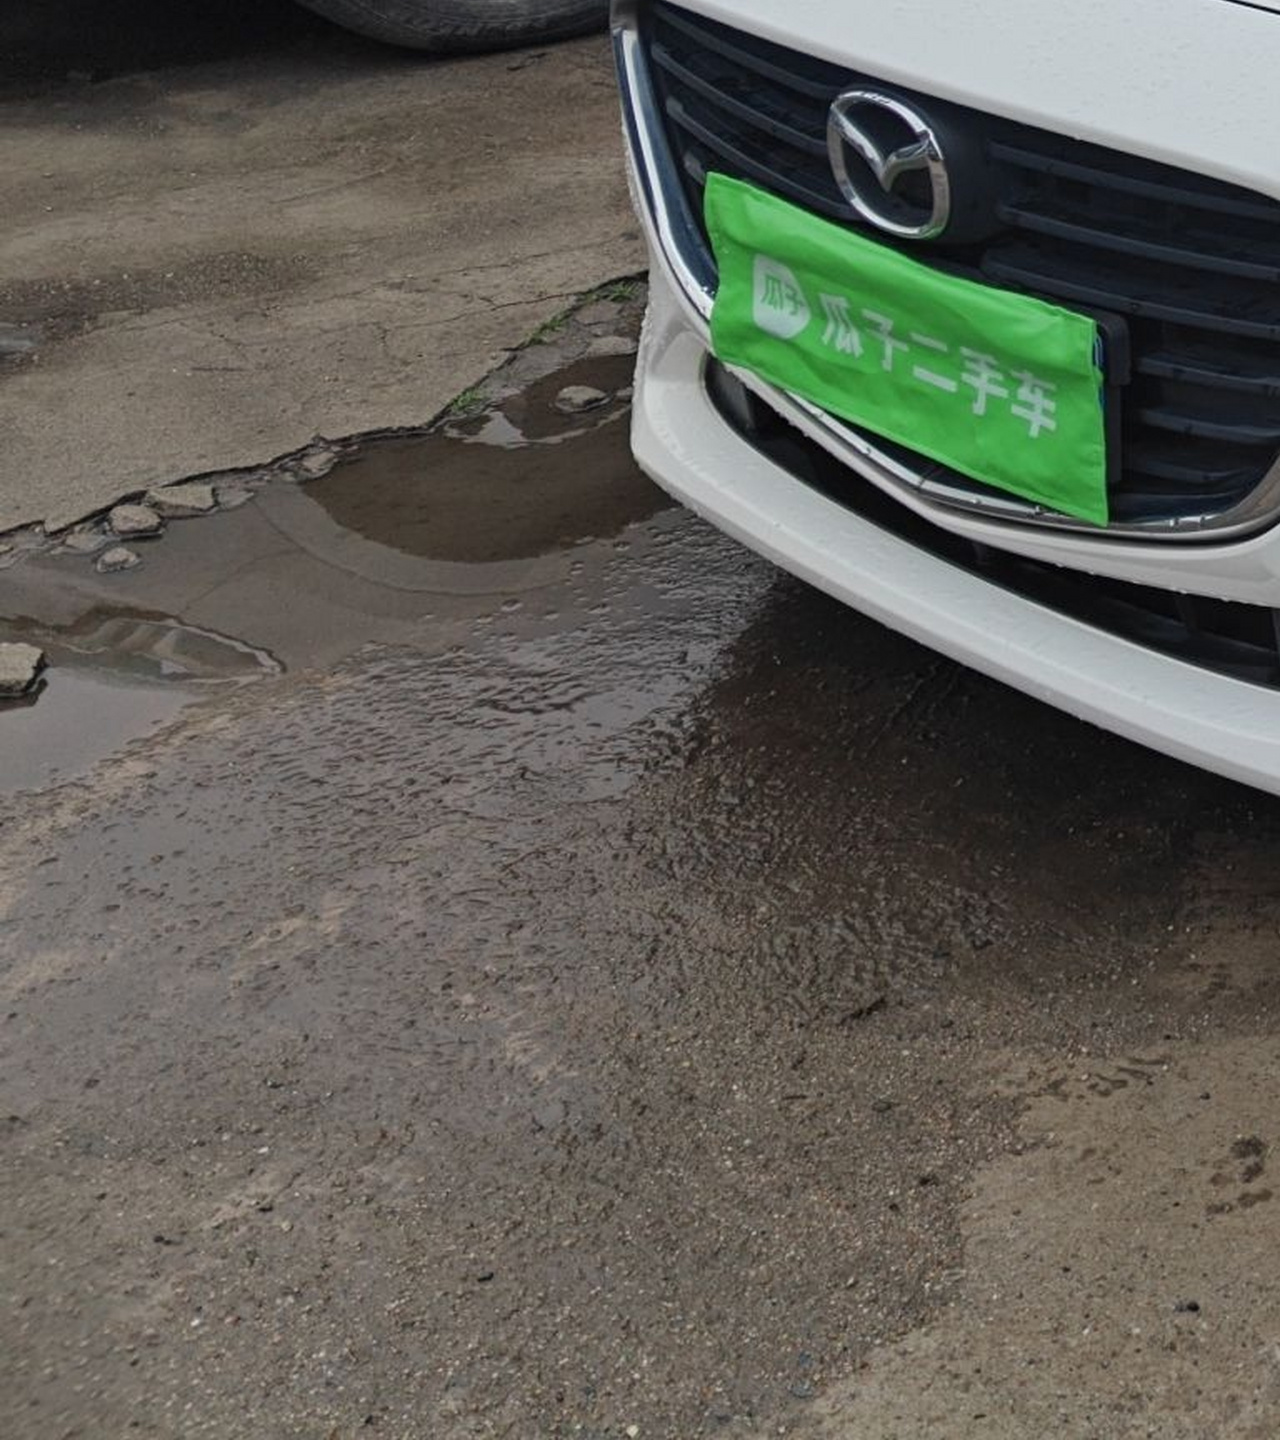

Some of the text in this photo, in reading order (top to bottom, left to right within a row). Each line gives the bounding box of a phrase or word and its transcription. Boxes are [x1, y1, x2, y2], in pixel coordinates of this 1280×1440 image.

[818, 292, 1057, 439] 瓜子二手车
